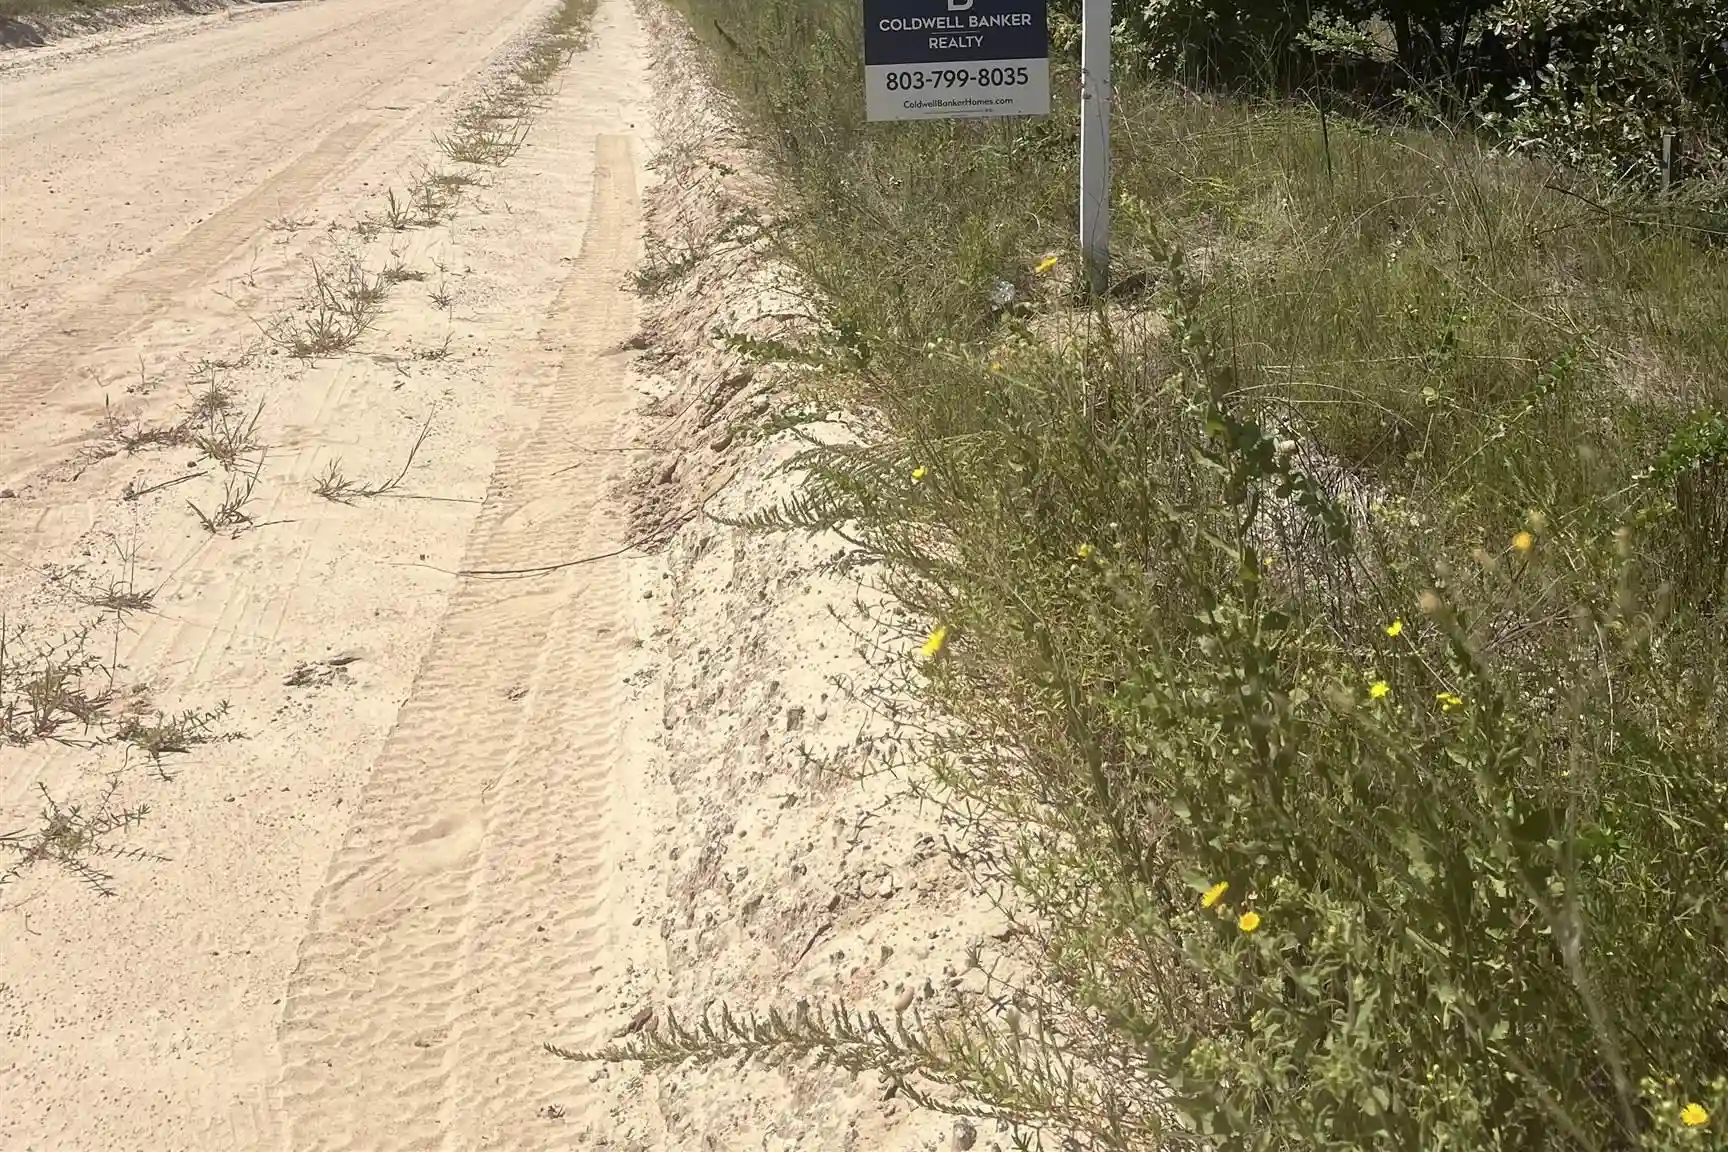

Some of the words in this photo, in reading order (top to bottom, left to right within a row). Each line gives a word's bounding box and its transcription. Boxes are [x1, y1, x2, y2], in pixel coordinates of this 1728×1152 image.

[879, 15, 964, 32] COLDWELL
[968, 13, 1032, 28] BANKER
[928, 35, 984, 49] REALTY
[886, 67, 1028, 91] 803-799-8035
[903, 97, 1013, 109] ColdwellBankerHomes.com
